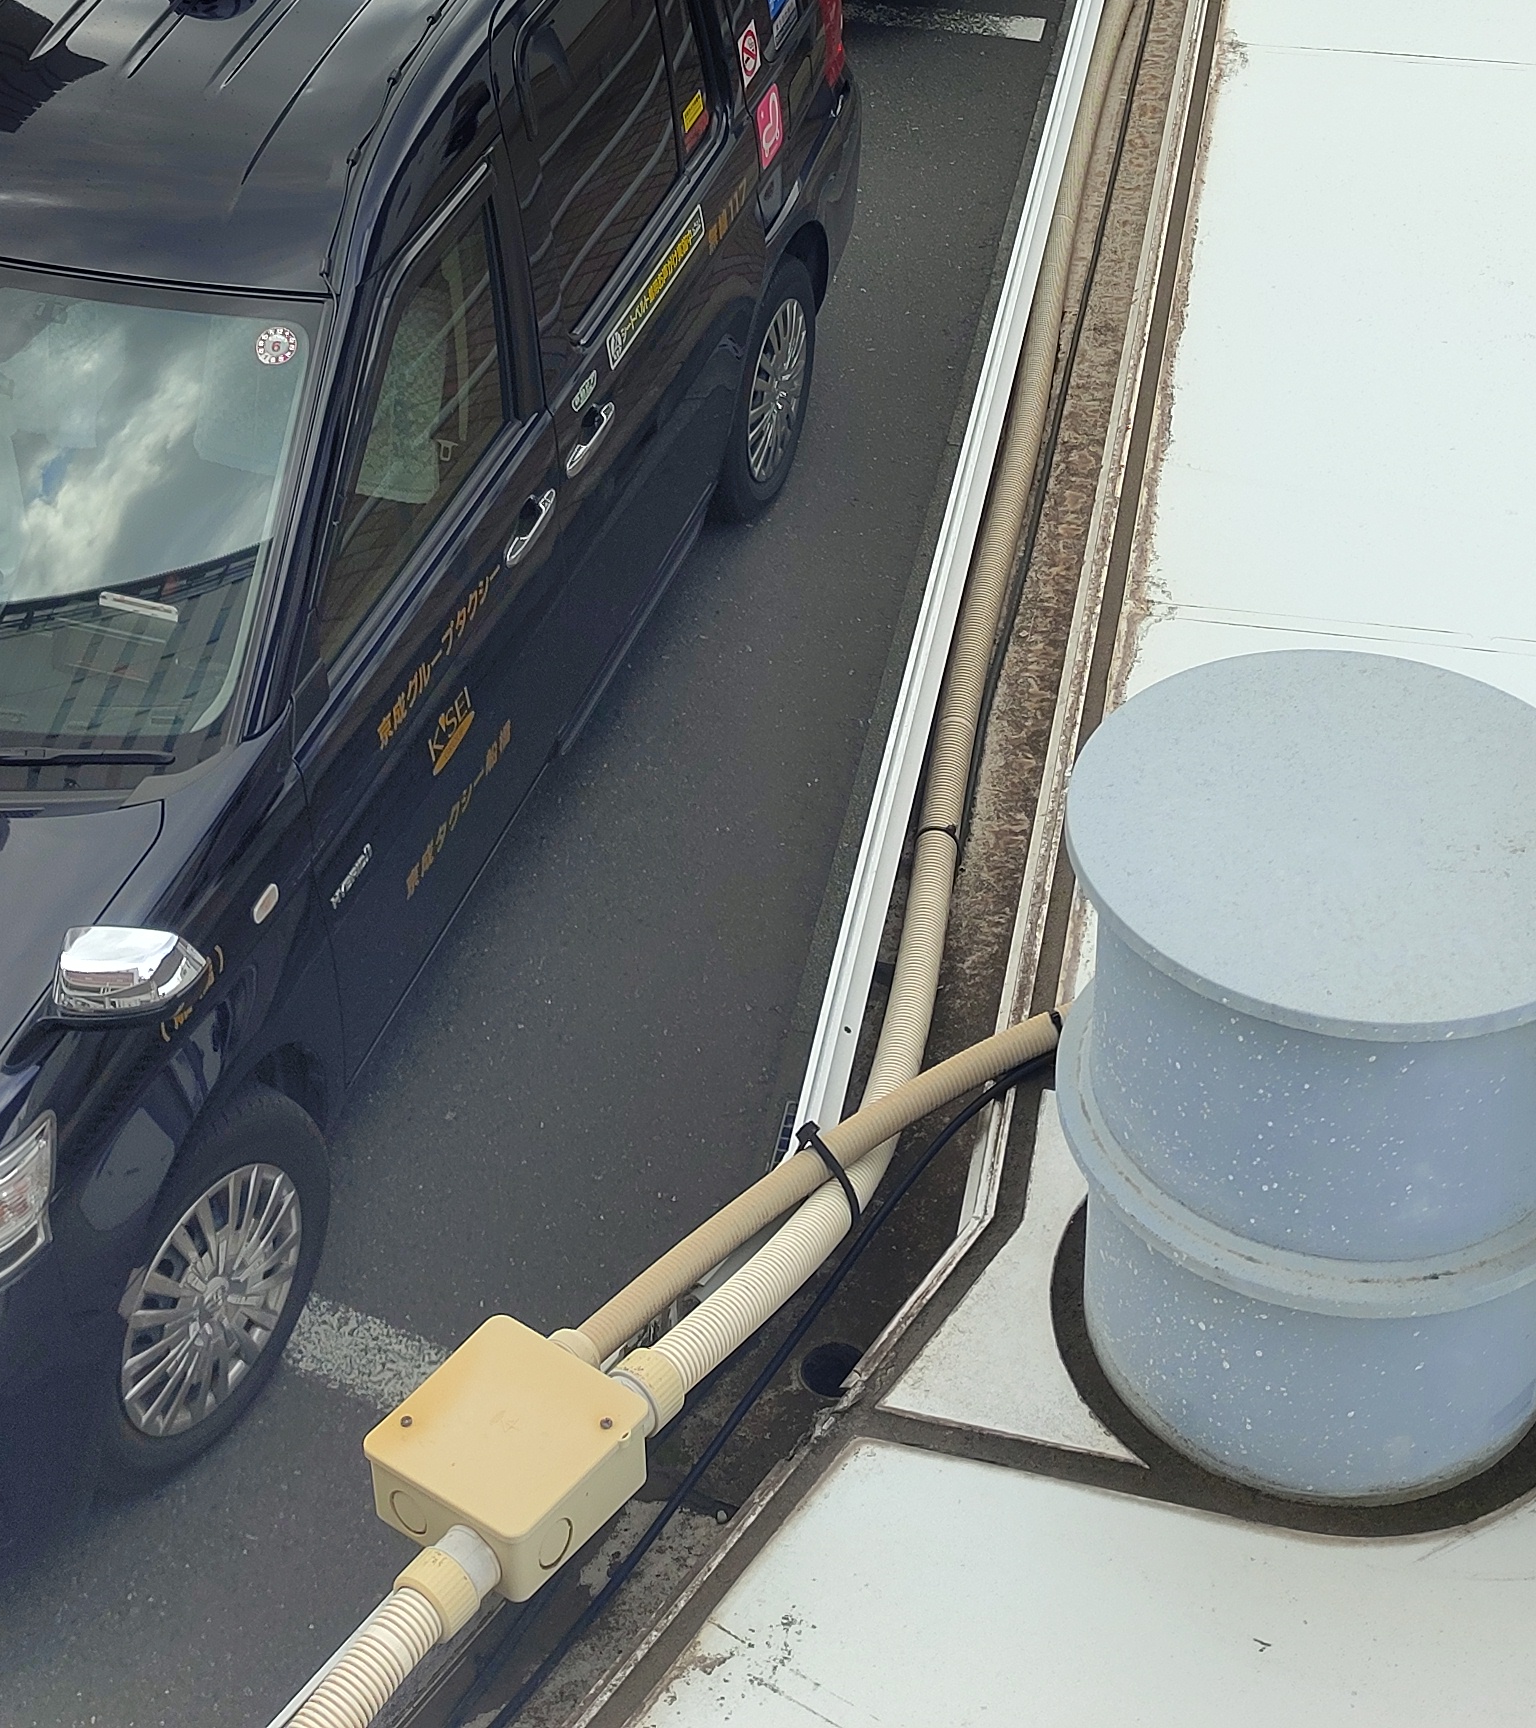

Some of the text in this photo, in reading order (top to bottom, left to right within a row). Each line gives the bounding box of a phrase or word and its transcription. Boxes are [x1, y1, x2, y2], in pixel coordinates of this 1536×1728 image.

[377, 564, 501, 751] 京成グループタクシー
[406, 719, 512, 901] 京成タクシー船橋
